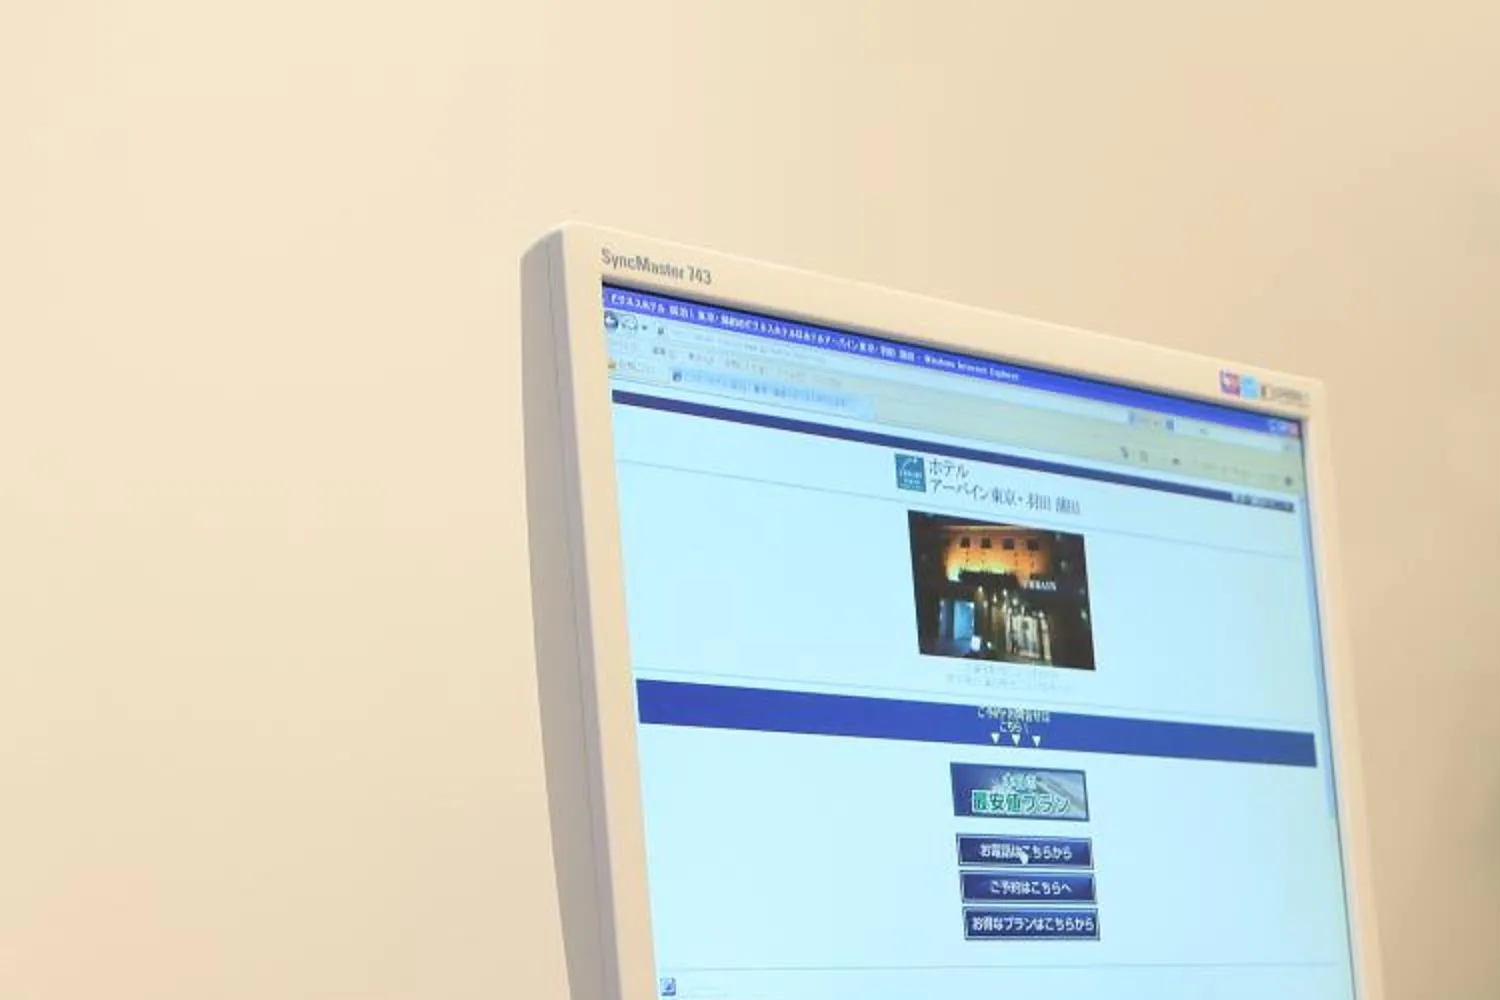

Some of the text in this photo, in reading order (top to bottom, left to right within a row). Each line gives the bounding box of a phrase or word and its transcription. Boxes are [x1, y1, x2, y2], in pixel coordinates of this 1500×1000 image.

[601, 248, 712, 285] SyncMaster 743
[929, 458, 970, 479] ホテル
